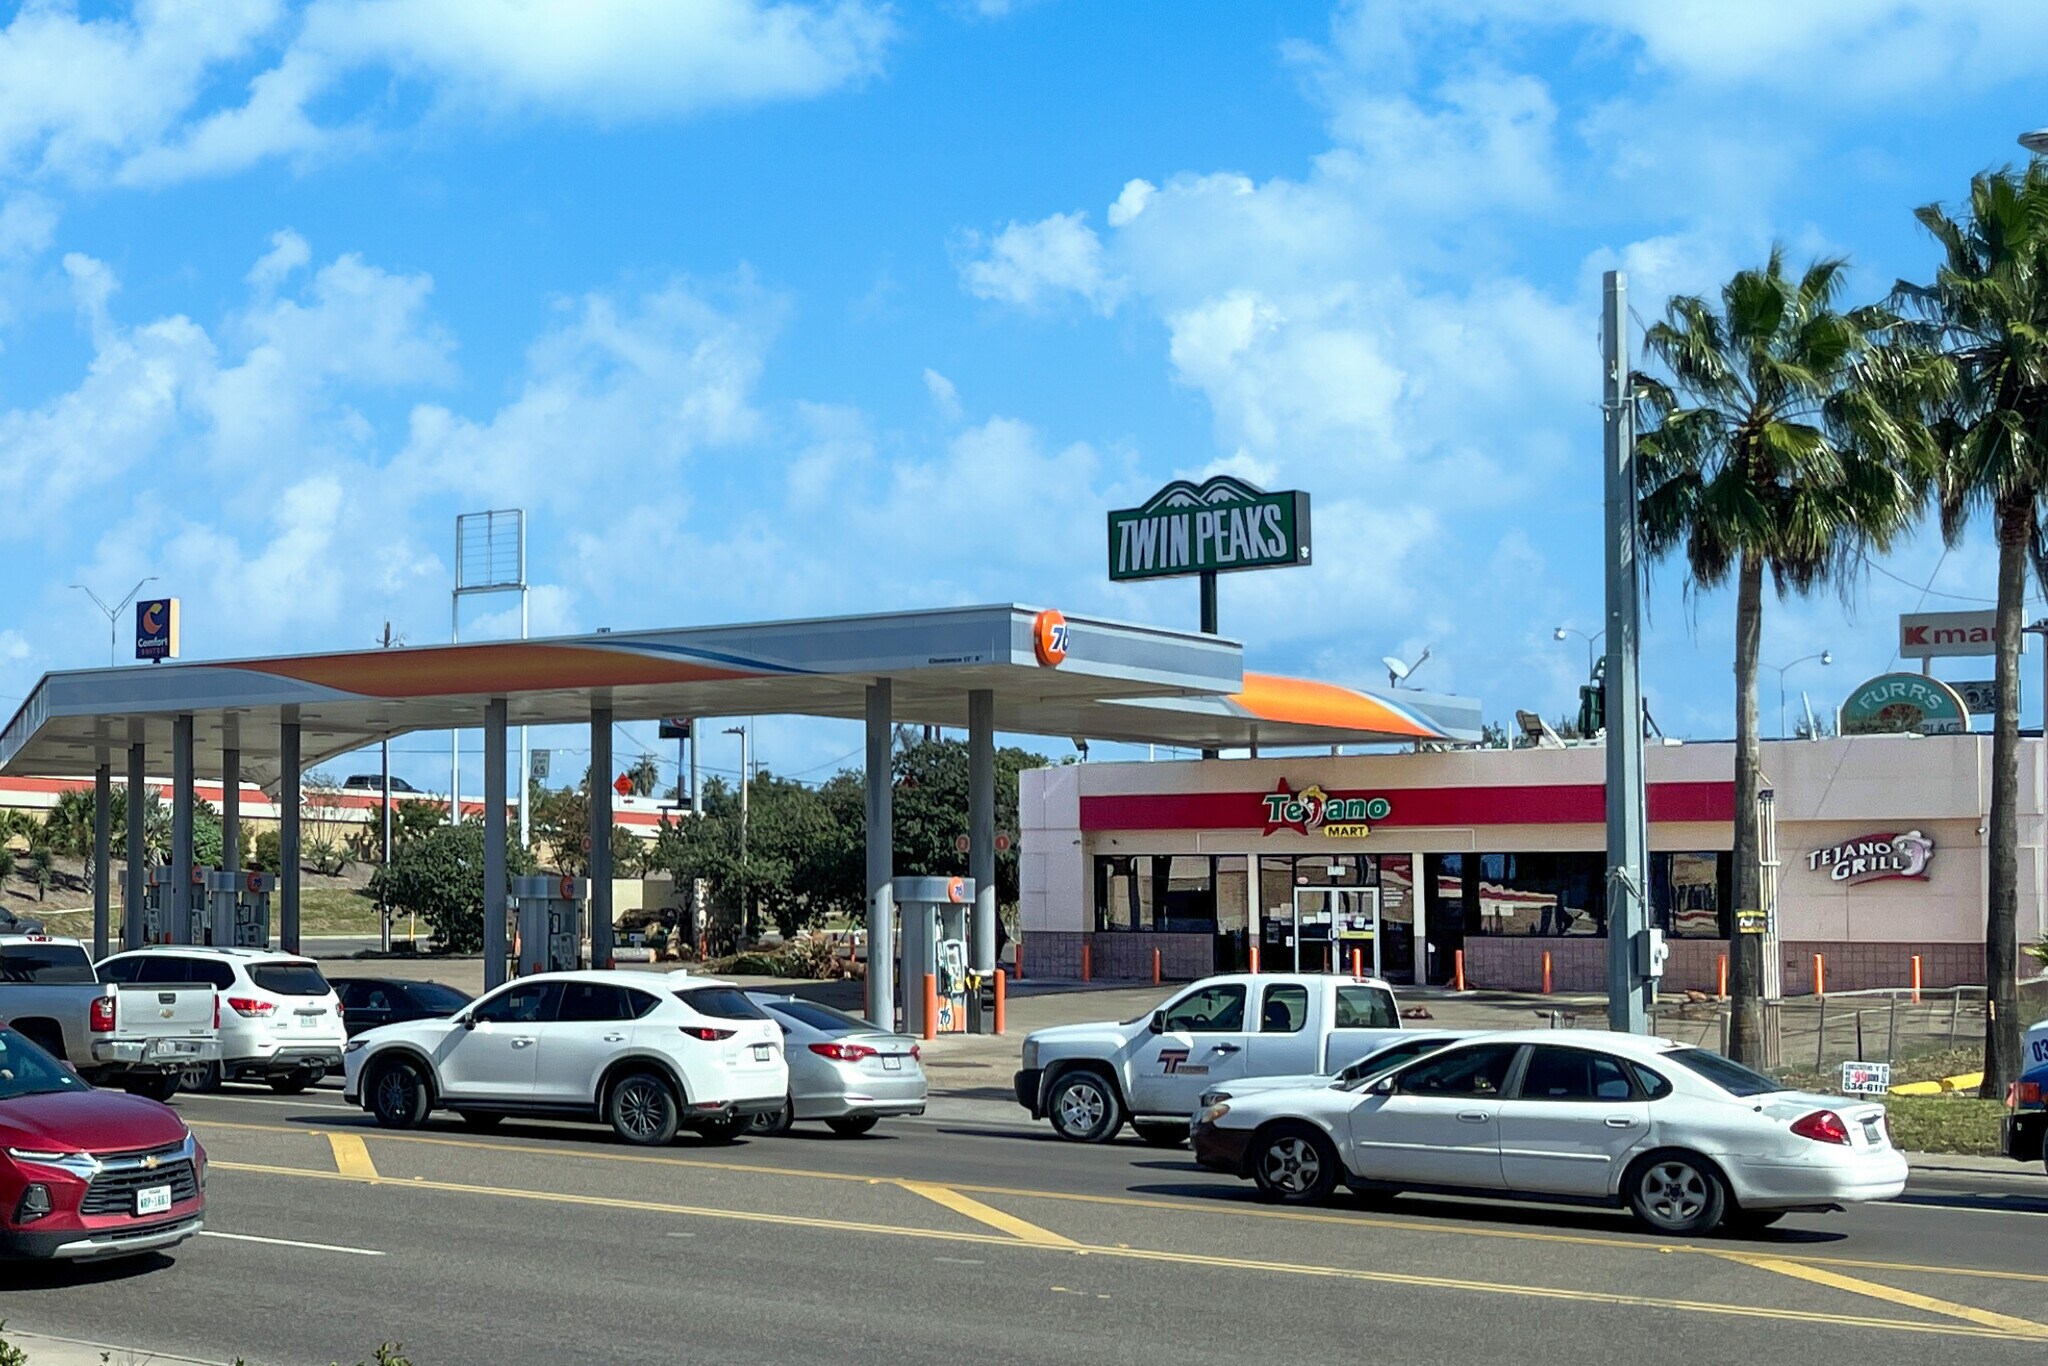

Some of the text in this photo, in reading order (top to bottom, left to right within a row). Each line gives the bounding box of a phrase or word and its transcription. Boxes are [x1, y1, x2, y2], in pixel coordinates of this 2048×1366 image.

[1118, 504, 1287, 572] TWIN PEAKS
[138, 637, 168, 648] Comfort
[1049, 624, 1070, 652] 76
[1904, 625, 1998, 646] Kma
[1857, 682, 1943, 710] FURR'S
[533, 765, 546, 774] 65
[1328, 827, 1365, 836] MART
[1806, 842, 1892, 871] TEJANO
[1831, 857, 1904, 881] GRILL
[954, 884, 964, 895] 76
